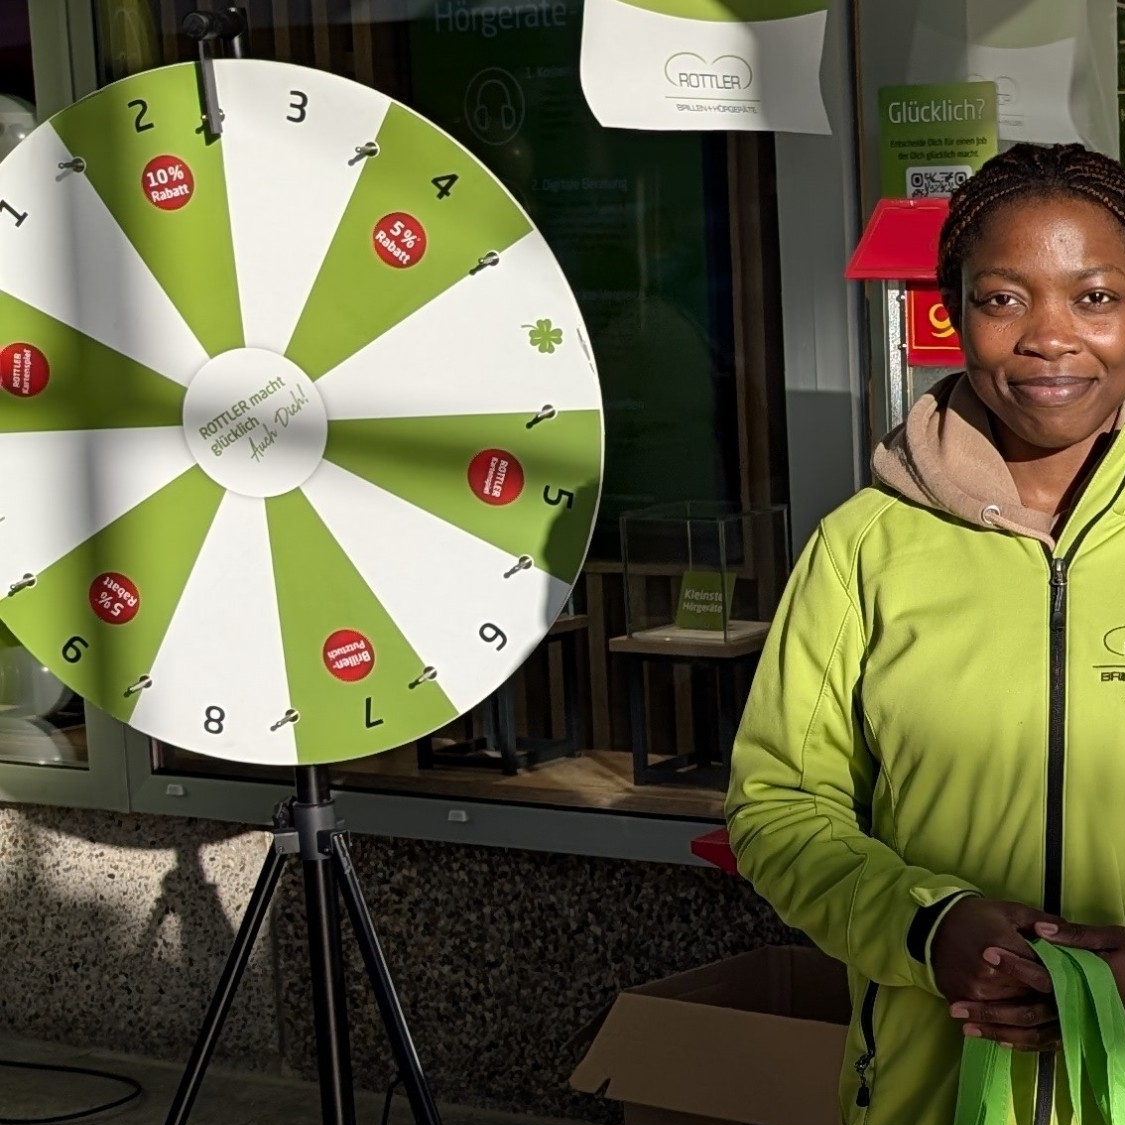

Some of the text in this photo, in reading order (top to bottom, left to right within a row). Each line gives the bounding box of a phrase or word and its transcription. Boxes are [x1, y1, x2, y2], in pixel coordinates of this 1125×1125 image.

[678, 72, 742, 90] ROTTLER
[127, 99, 155, 133] 2
[286, 90, 308, 123] 3
[888, 98, 986, 124] Glücklich?
[975, 136, 988, 147] Job
[150, 183, 190, 203] Rabatt
[431, 173, 459, 200] 4
[0, 199, 29, 228] 1
[375, 229, 411, 265] Rabatt
[198, 376, 286, 440] ROTTLER macht
[248, 383, 309, 463] Auch Dich!
[210, 416, 260, 457] glücklich
[491, 458, 508, 498] ROTTLER
[543, 484, 574, 510] 5
[102, 576, 138, 608] Rabatt
[327, 640, 366, 659] Putztuch
[332, 650, 371, 670] Brillen-
[203, 705, 226, 735] 8
[365, 696, 385, 729] 7
